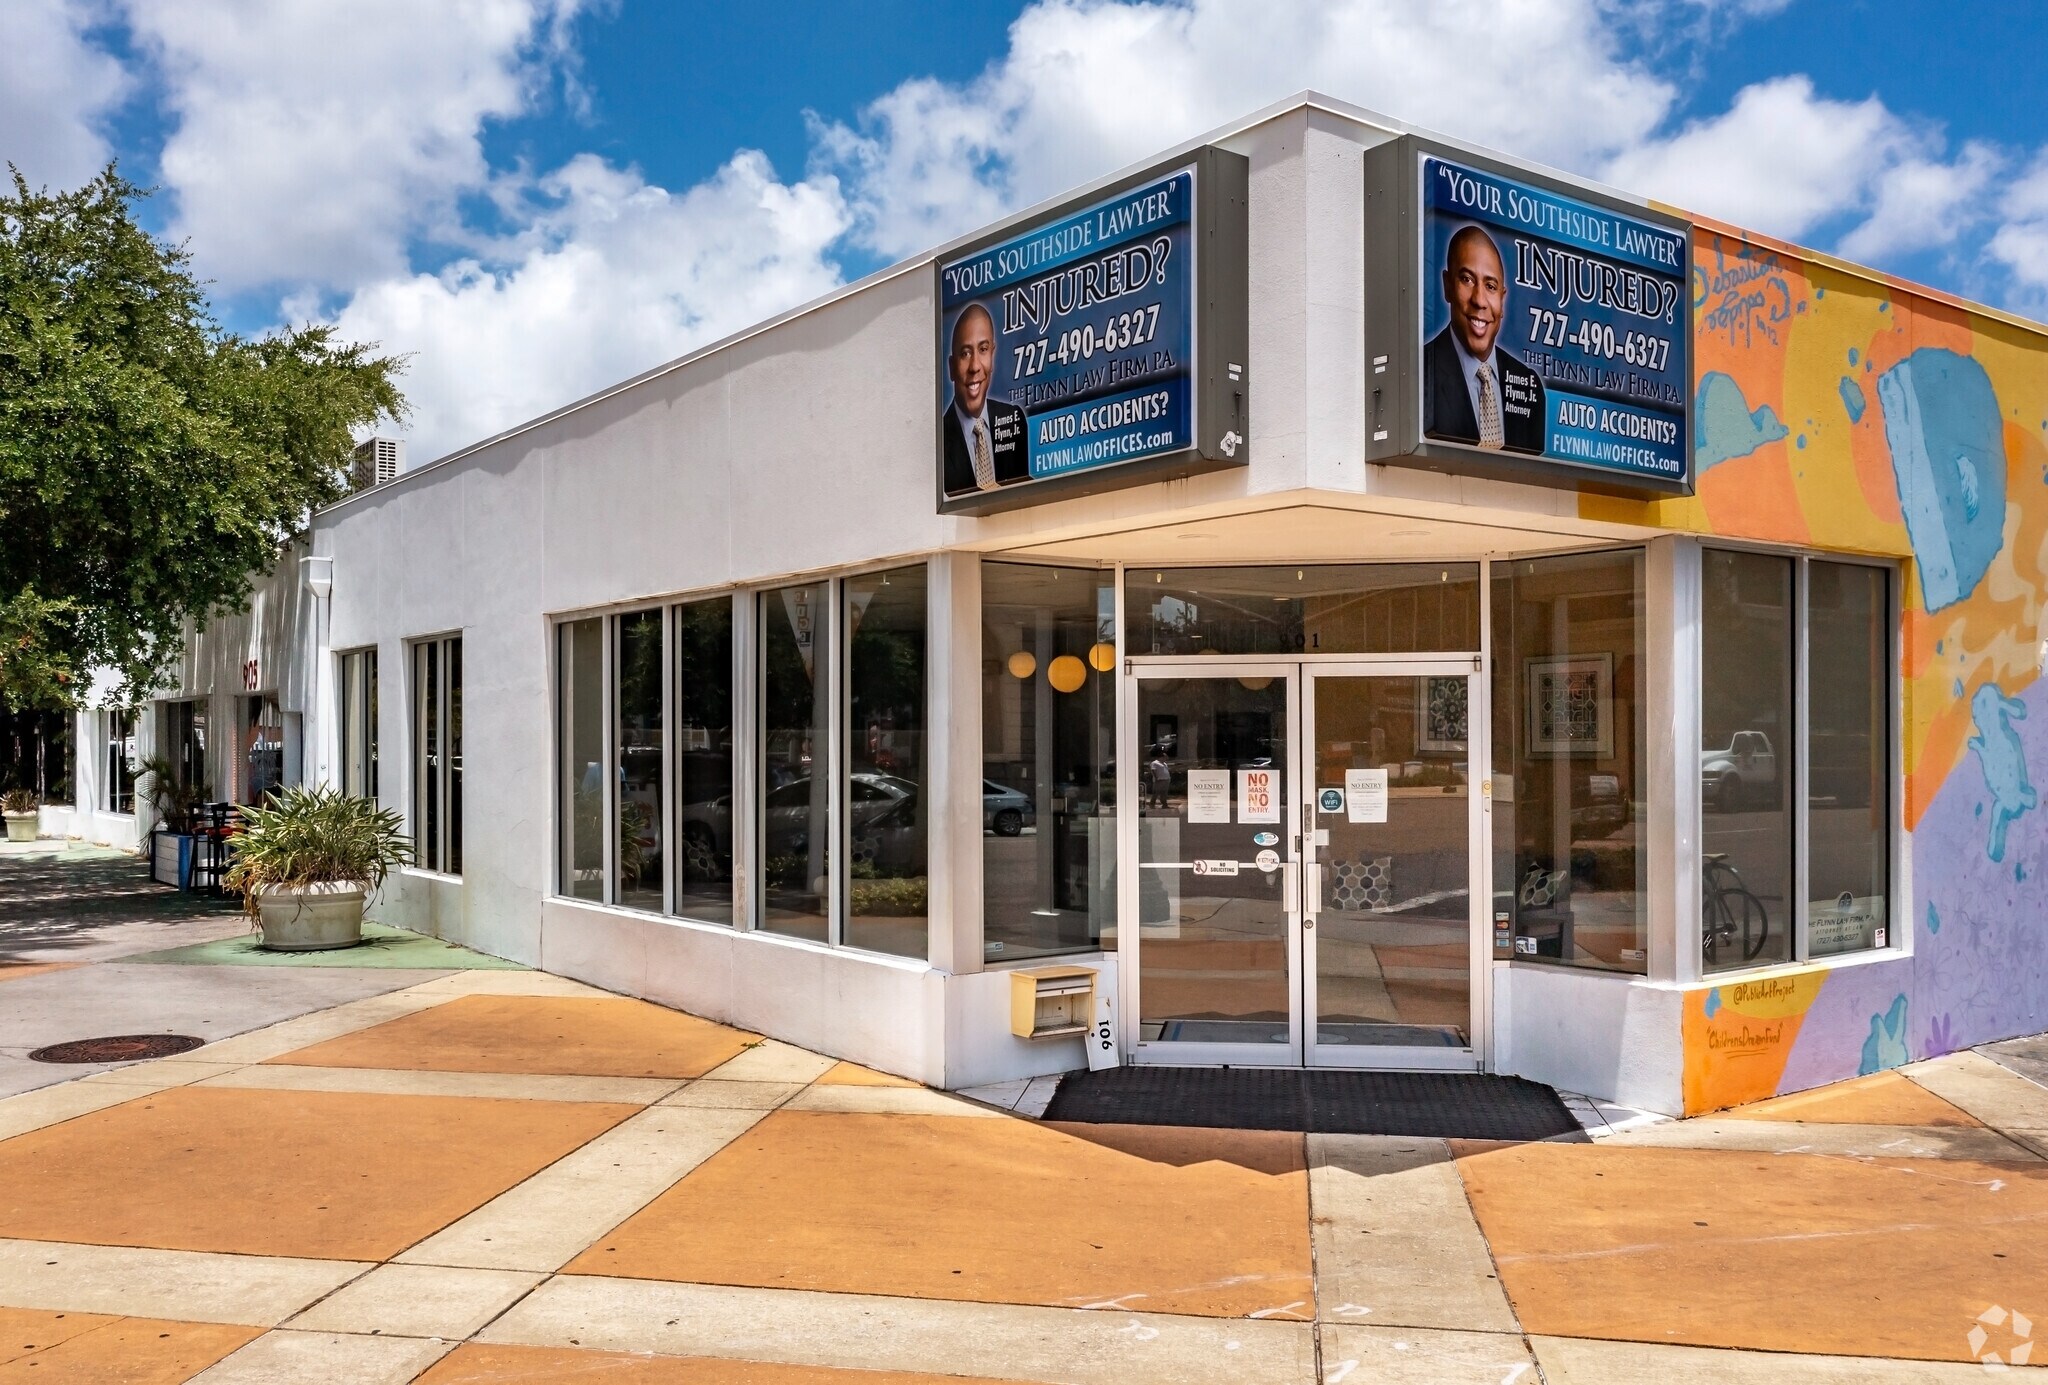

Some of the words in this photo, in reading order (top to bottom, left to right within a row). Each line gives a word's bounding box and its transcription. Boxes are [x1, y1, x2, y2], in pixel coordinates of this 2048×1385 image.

[1438, 165, 1505, 217] "YOUR
[1508, 189, 1610, 248] SOUTHSIDE
[1614, 221, 1682, 267] LAWYER"
[945, 260, 995, 296] "YOUR
[998, 221, 1093, 279] SOUTHSIDE
[1098, 181, 1178, 240] LAWYER"
[1002, 235, 1172, 335] INJURED?
[1514, 238, 1679, 325] INJURED?
[1013, 303, 1162, 381] 727-490-6327
[1528, 306, 1670, 373] 727-490-6327
[1008, 387, 1024, 404] THE
[1024, 375, 1070, 408] FLYNN
[1072, 367, 1105, 394] LAW
[1108, 354, 1149, 385] FIRM
[1505, 370, 1529, 386] James
[1530, 374, 1537, 388] E.
[1523, 348, 1542, 366] THE
[1542, 354, 1591, 384] FLYNN
[1594, 366, 1626, 392] LAW
[1628, 373, 1663, 400] FIRM
[1505, 384, 1528, 403] Flynn,
[1529, 389, 1537, 402] Jr.
[1505, 401, 1531, 418] Attorney
[994, 427, 1013, 442] Flynn,
[1013, 423, 1021, 436] Jr.
[995, 414, 1013, 427] James
[1014, 410, 1020, 422] E.
[1039, 414, 1076, 445] AUTO
[1079, 391, 1169, 435] ACCIDENTS?
[1558, 400, 1597, 431] AUTO
[1600, 409, 1678, 446] ACCIDENTS?
[994, 441, 1016, 454] Attorney
[1035, 430, 1173, 473] FLYNNLAWOFFICES.com
[1553, 434, 1680, 473] FLYNNLAWOFFICES.com
[243, 659, 258, 691] 905
[1248, 773, 1269, 787] NO
[1248, 793, 1269, 807] NO
[1816, 918, 1835, 927] FLYNN
[1816, 936, 1832, 945] (727)
[1098, 1020, 1113, 1050] 901
